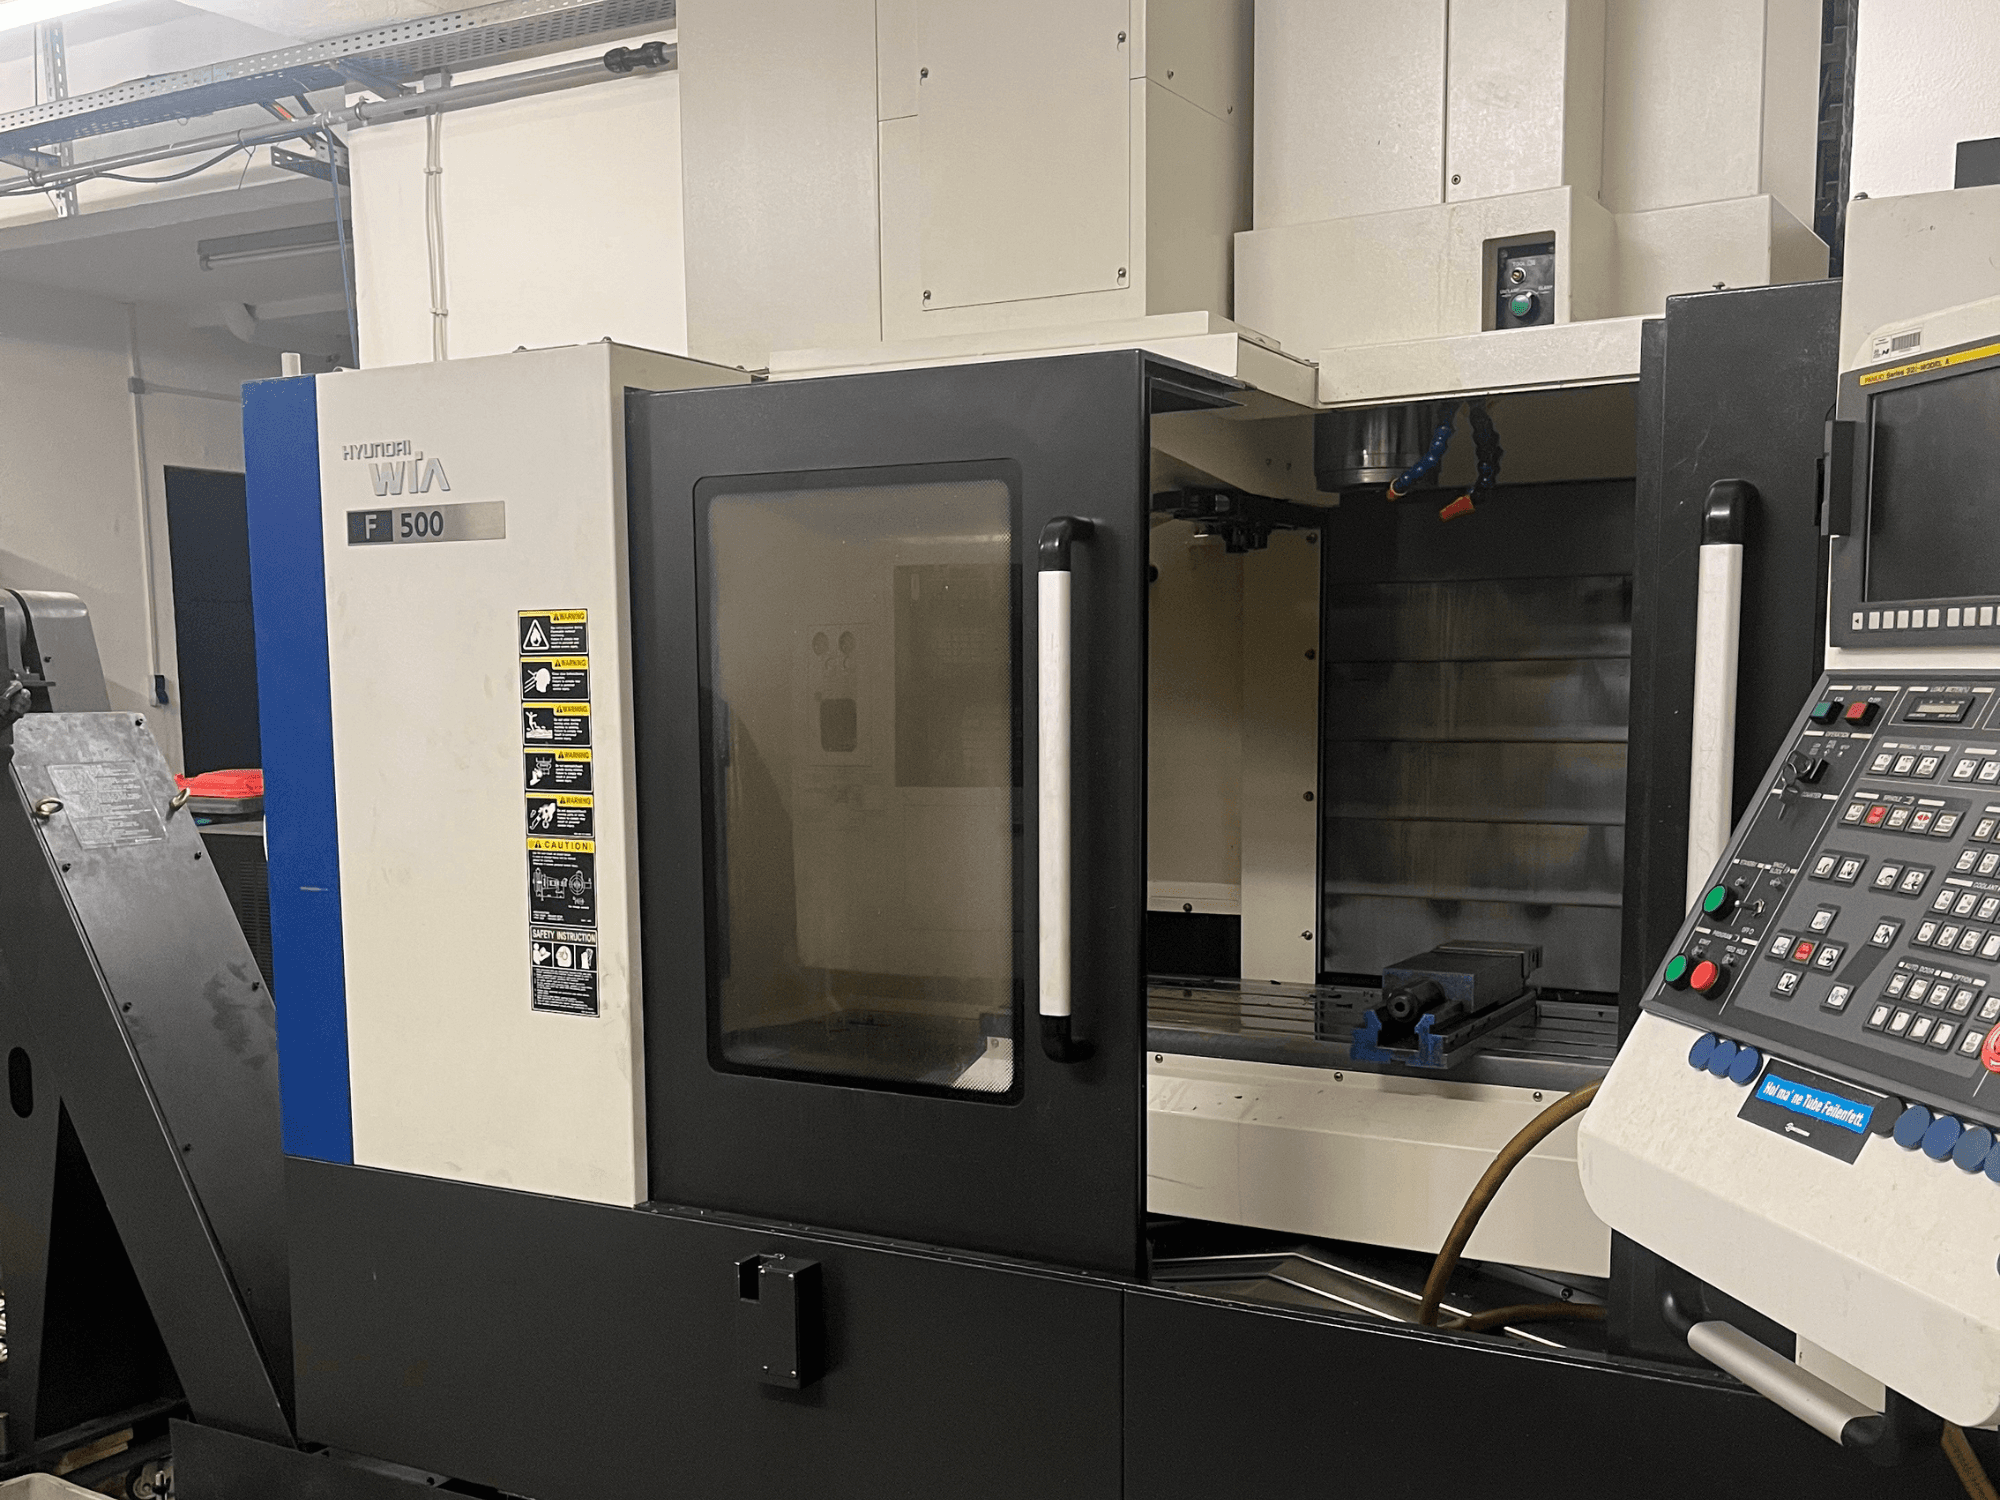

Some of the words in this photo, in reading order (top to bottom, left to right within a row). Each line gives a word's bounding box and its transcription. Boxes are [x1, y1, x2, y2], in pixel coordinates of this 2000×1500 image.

[1886, 369, 1904, 378] Series
[342, 440, 411, 460] HYUNDAI
[364, 514, 377, 539] F
[400, 510, 444, 538] 500
[559, 612, 585, 620] WARNING
[544, 841, 588, 850] CAUTION
[1972, 882, 1998, 891] COOLANT
[532, 929, 556, 940] SAFETY
[556, 930, 596, 943] INSTRUCTION
[1763, 1082, 1780, 1098] Hol
[1803, 1094, 1824, 1112] Tube
[1821, 1100, 1865, 1127] Feilenfett.
